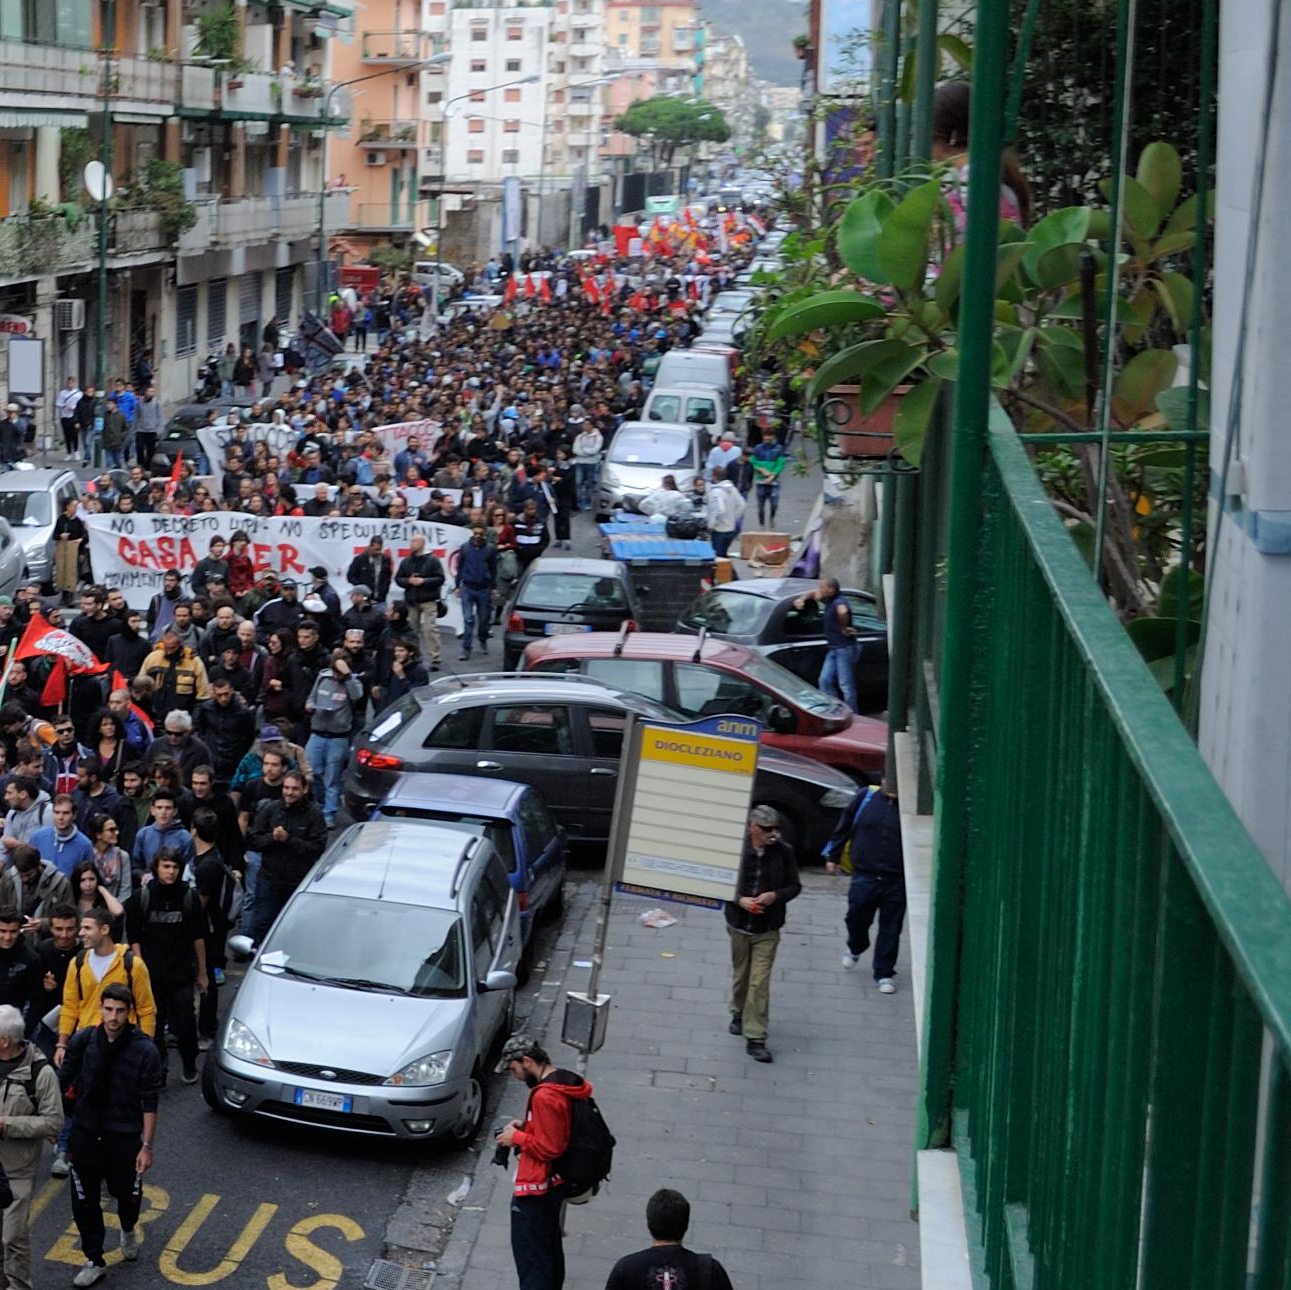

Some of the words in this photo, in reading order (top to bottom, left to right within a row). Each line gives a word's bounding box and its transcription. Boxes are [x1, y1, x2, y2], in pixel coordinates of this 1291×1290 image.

[111, 519, 134, 534] NO
[152, 517, 219, 534] DECRETO
[280, 521, 303, 537] NO
[117, 536, 199, 571] CASA
[252, 542, 306, 574] ER
[717, 720, 757, 737] anm
[655, 739, 744, 761] DIOCLEZIANO
[43, 1183, 366, 1290] BUS
